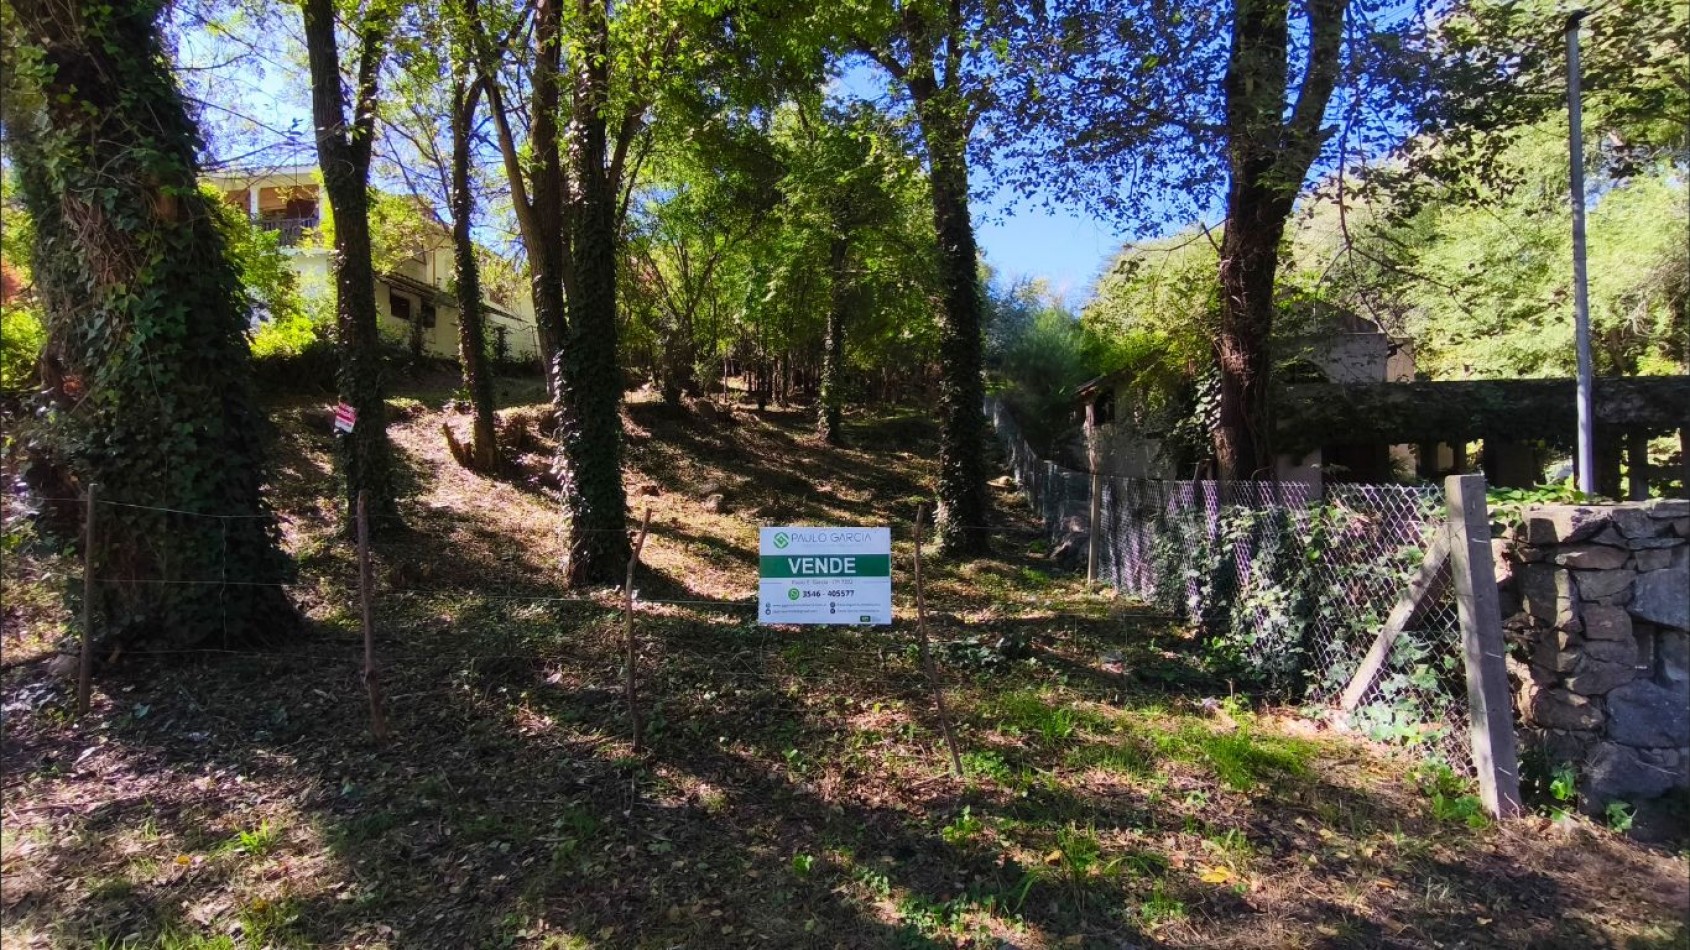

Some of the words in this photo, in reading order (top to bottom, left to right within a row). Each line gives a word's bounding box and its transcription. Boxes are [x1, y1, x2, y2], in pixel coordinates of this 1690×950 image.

[791, 533, 827, 543] PAULO
[788, 557, 856, 574] VENDE
[802, 590, 821, 598] 3546
[827, 590, 855, 598] 405577
